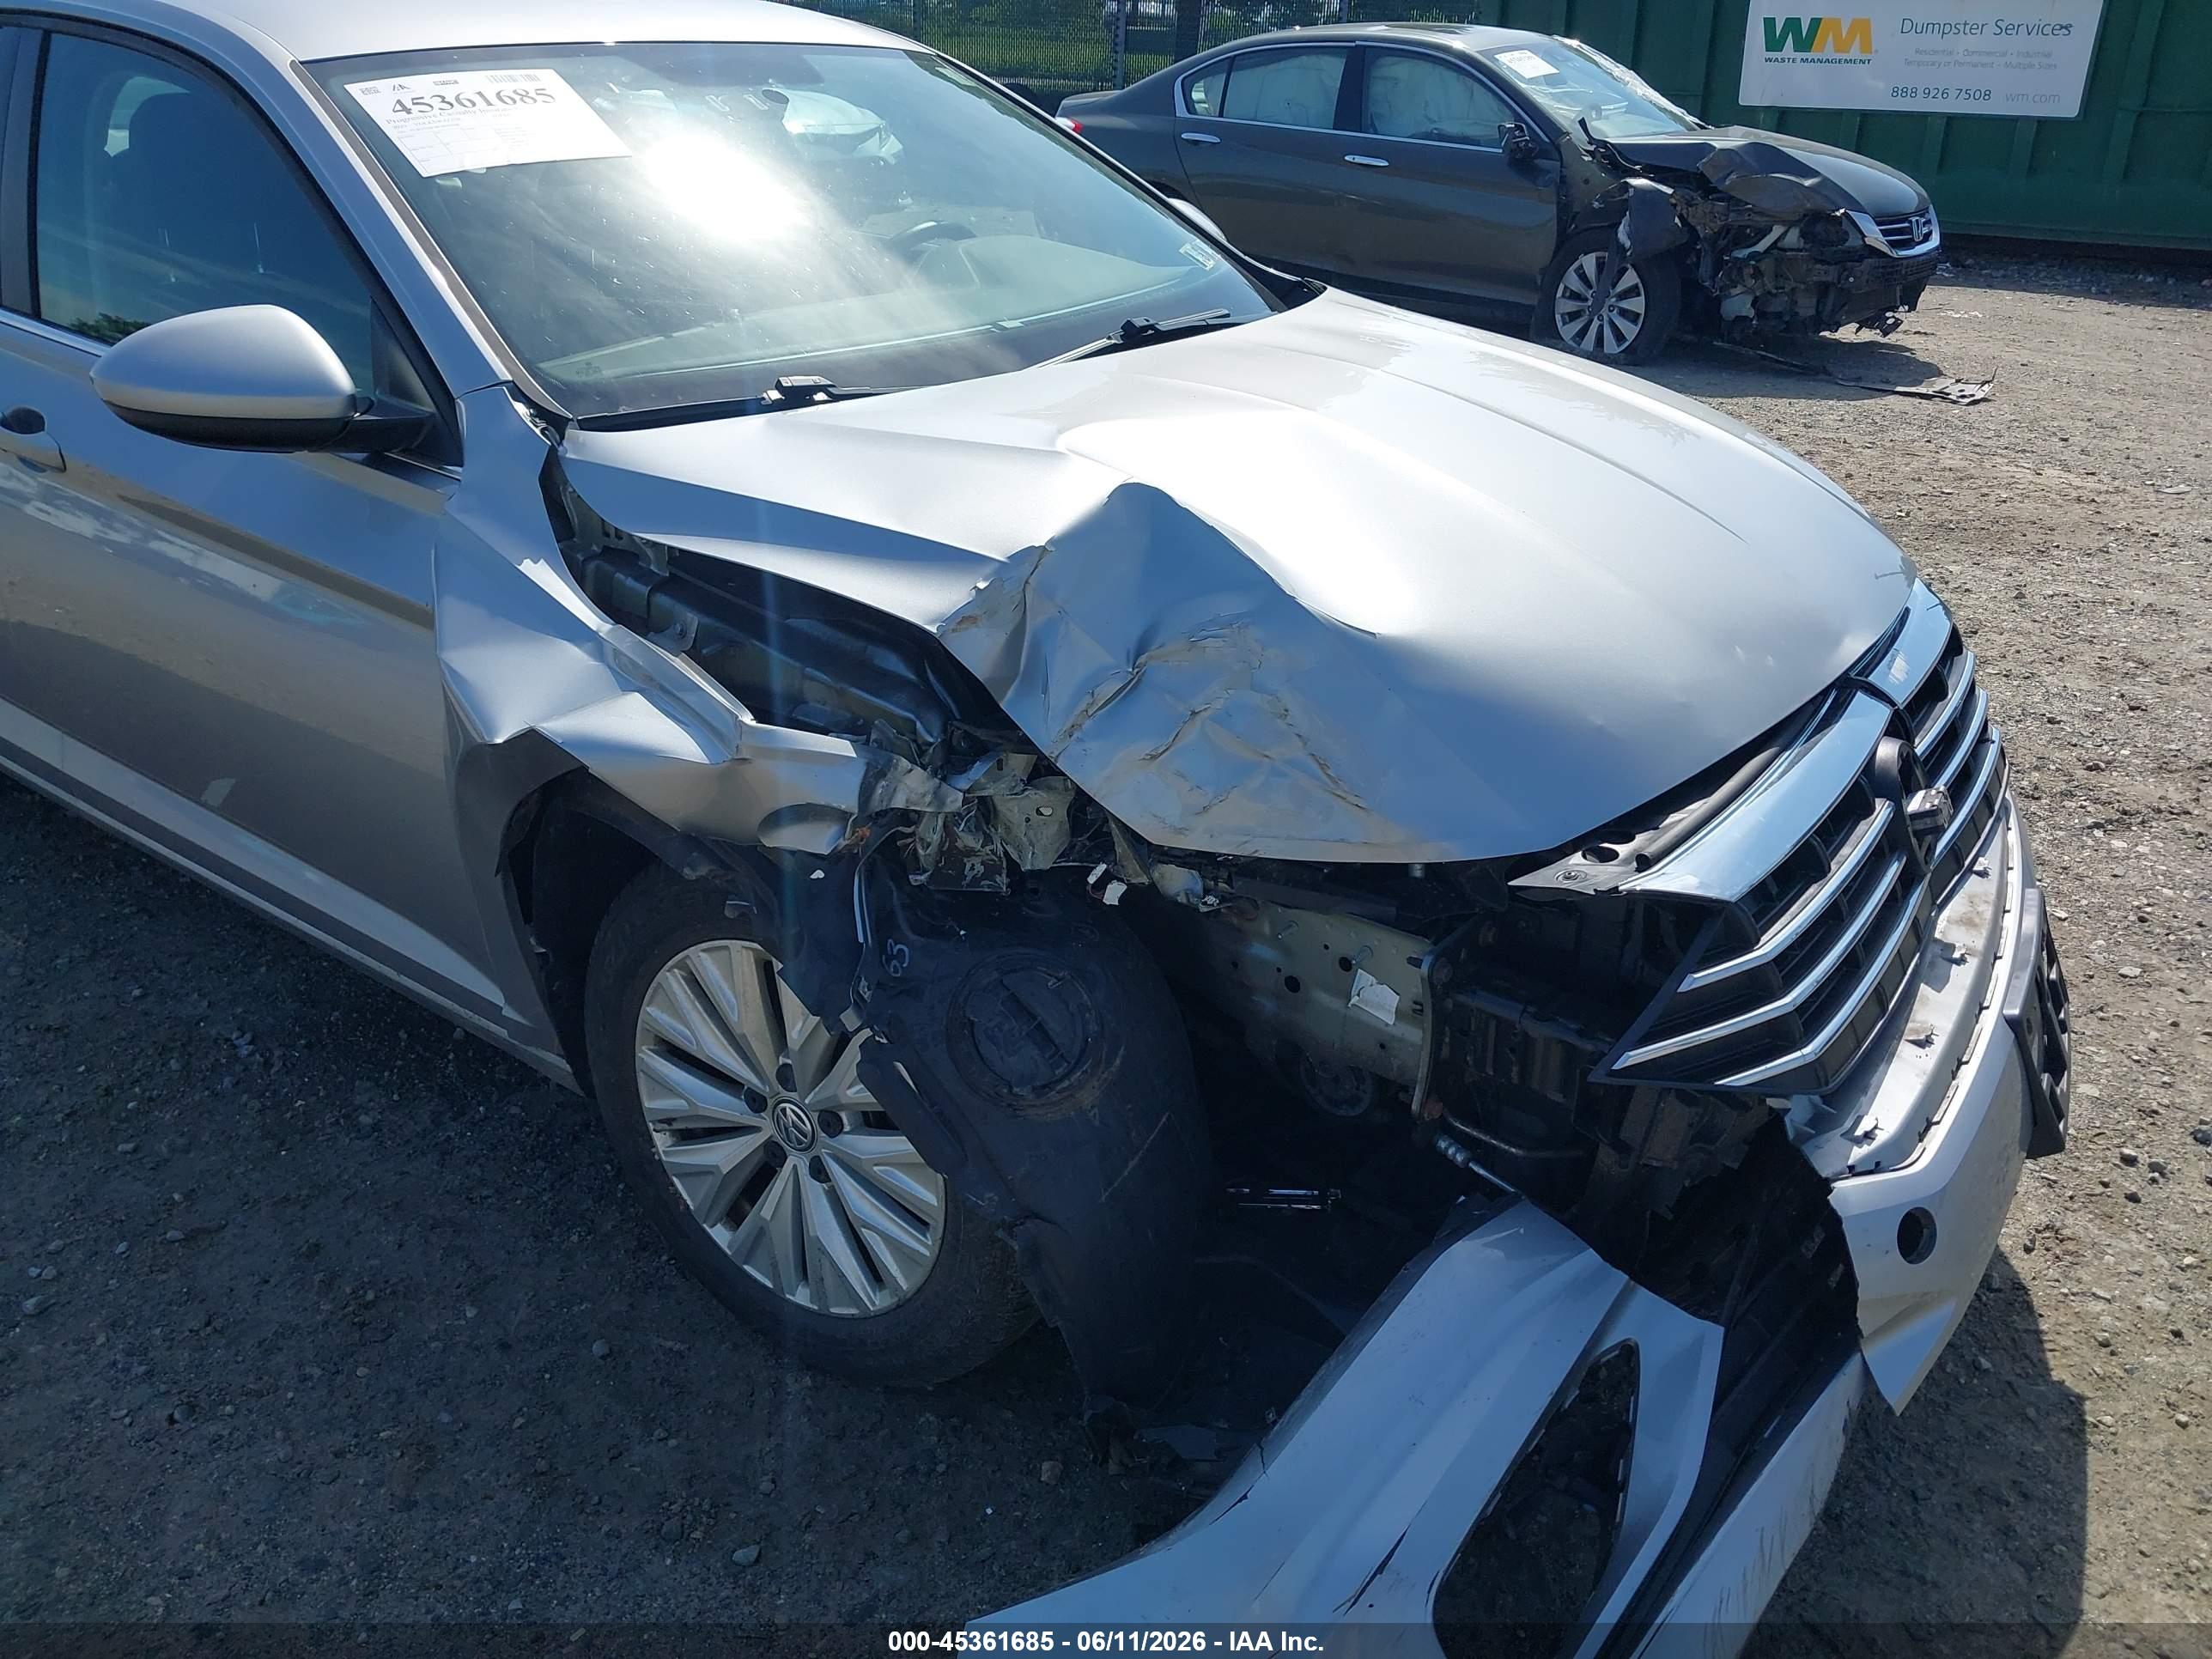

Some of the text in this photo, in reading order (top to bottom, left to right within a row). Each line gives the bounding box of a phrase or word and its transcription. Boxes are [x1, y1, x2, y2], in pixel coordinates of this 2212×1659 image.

[1763, 17, 1873, 54] WM
[1900, 18, 2073, 40] Dumpster Services
[1799, 57, 1872, 65] MANAGEMENT
[392, 88, 556, 115] 45361685
[1891, 87, 2061, 104] 888 926 7508 wm.com
